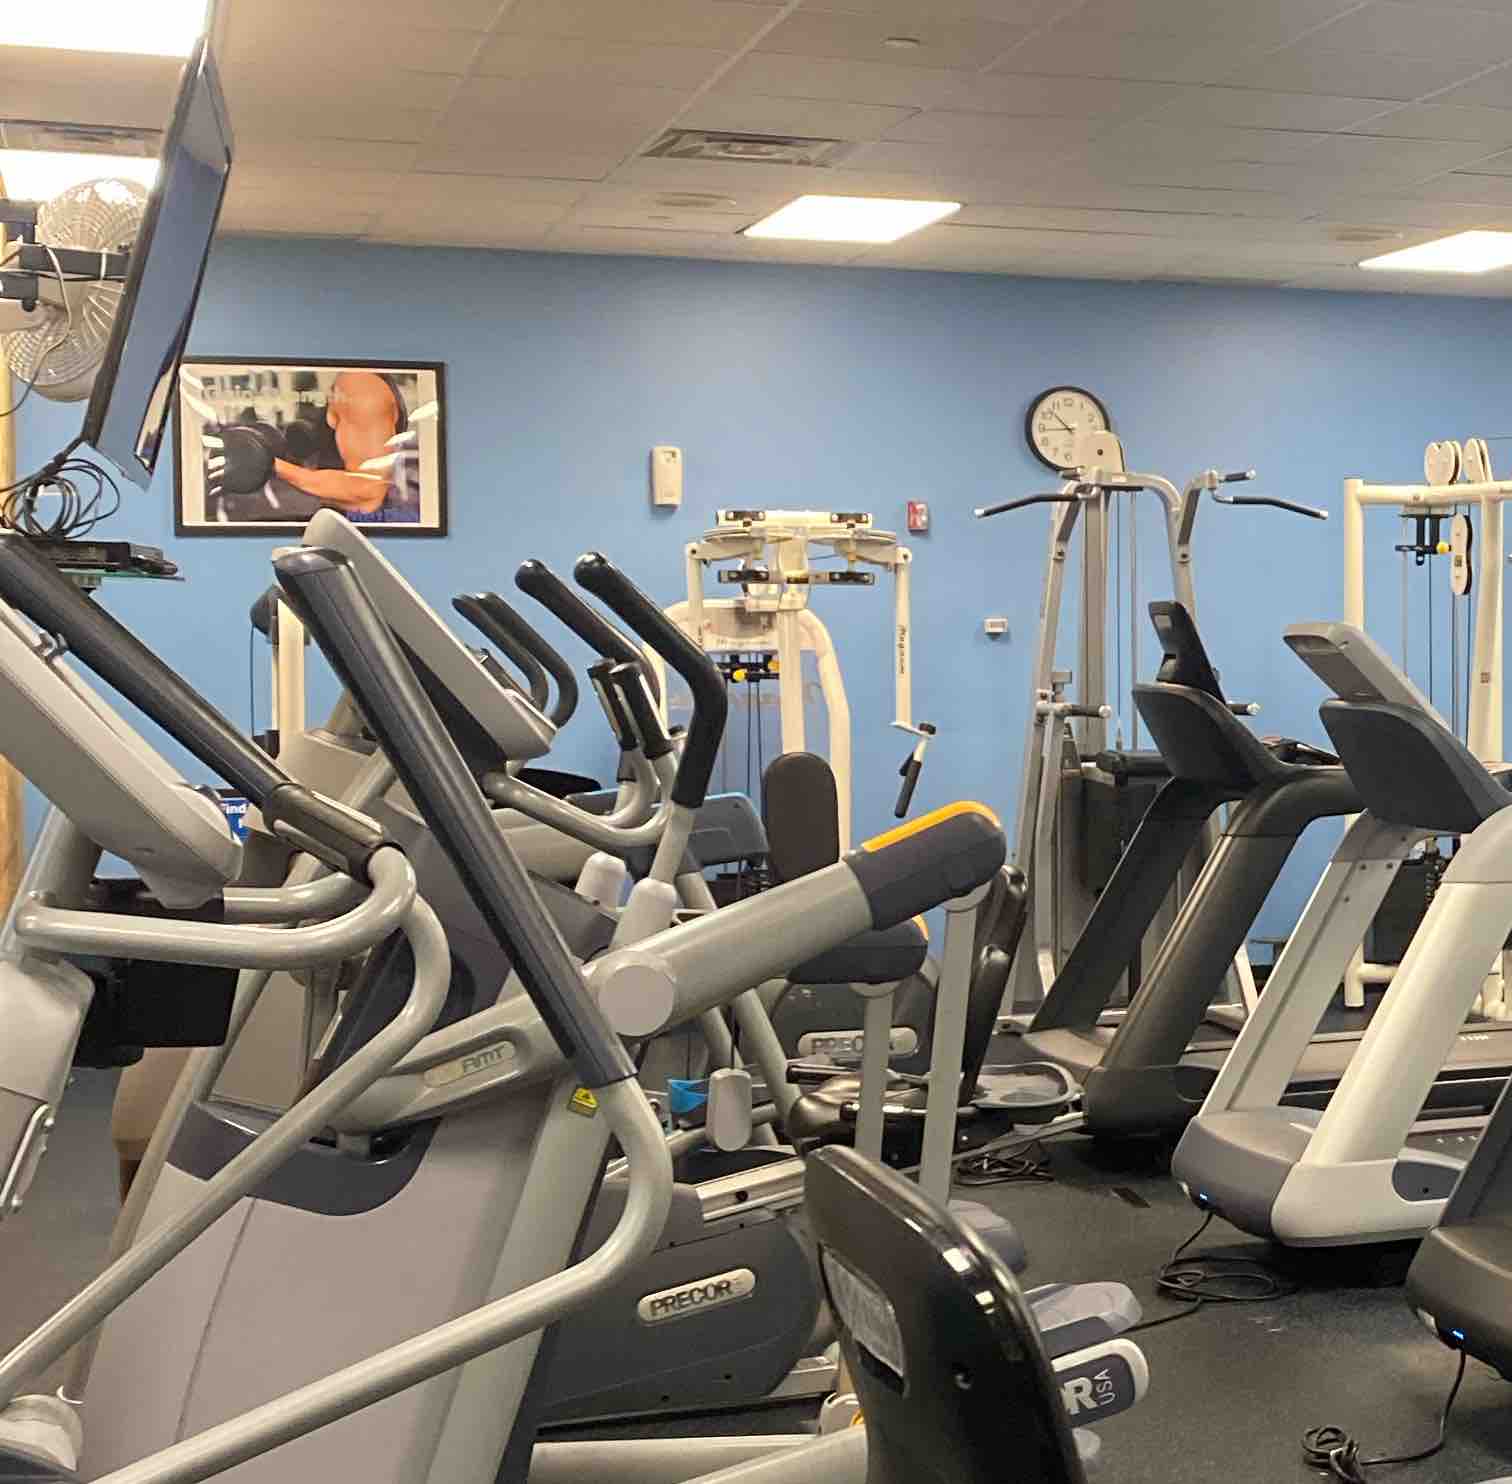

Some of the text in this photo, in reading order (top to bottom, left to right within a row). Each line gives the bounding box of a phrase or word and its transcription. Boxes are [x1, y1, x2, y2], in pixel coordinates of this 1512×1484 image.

[649, 1280, 734, 1316] PRECOR
[1060, 1369, 1117, 1416] R USA
